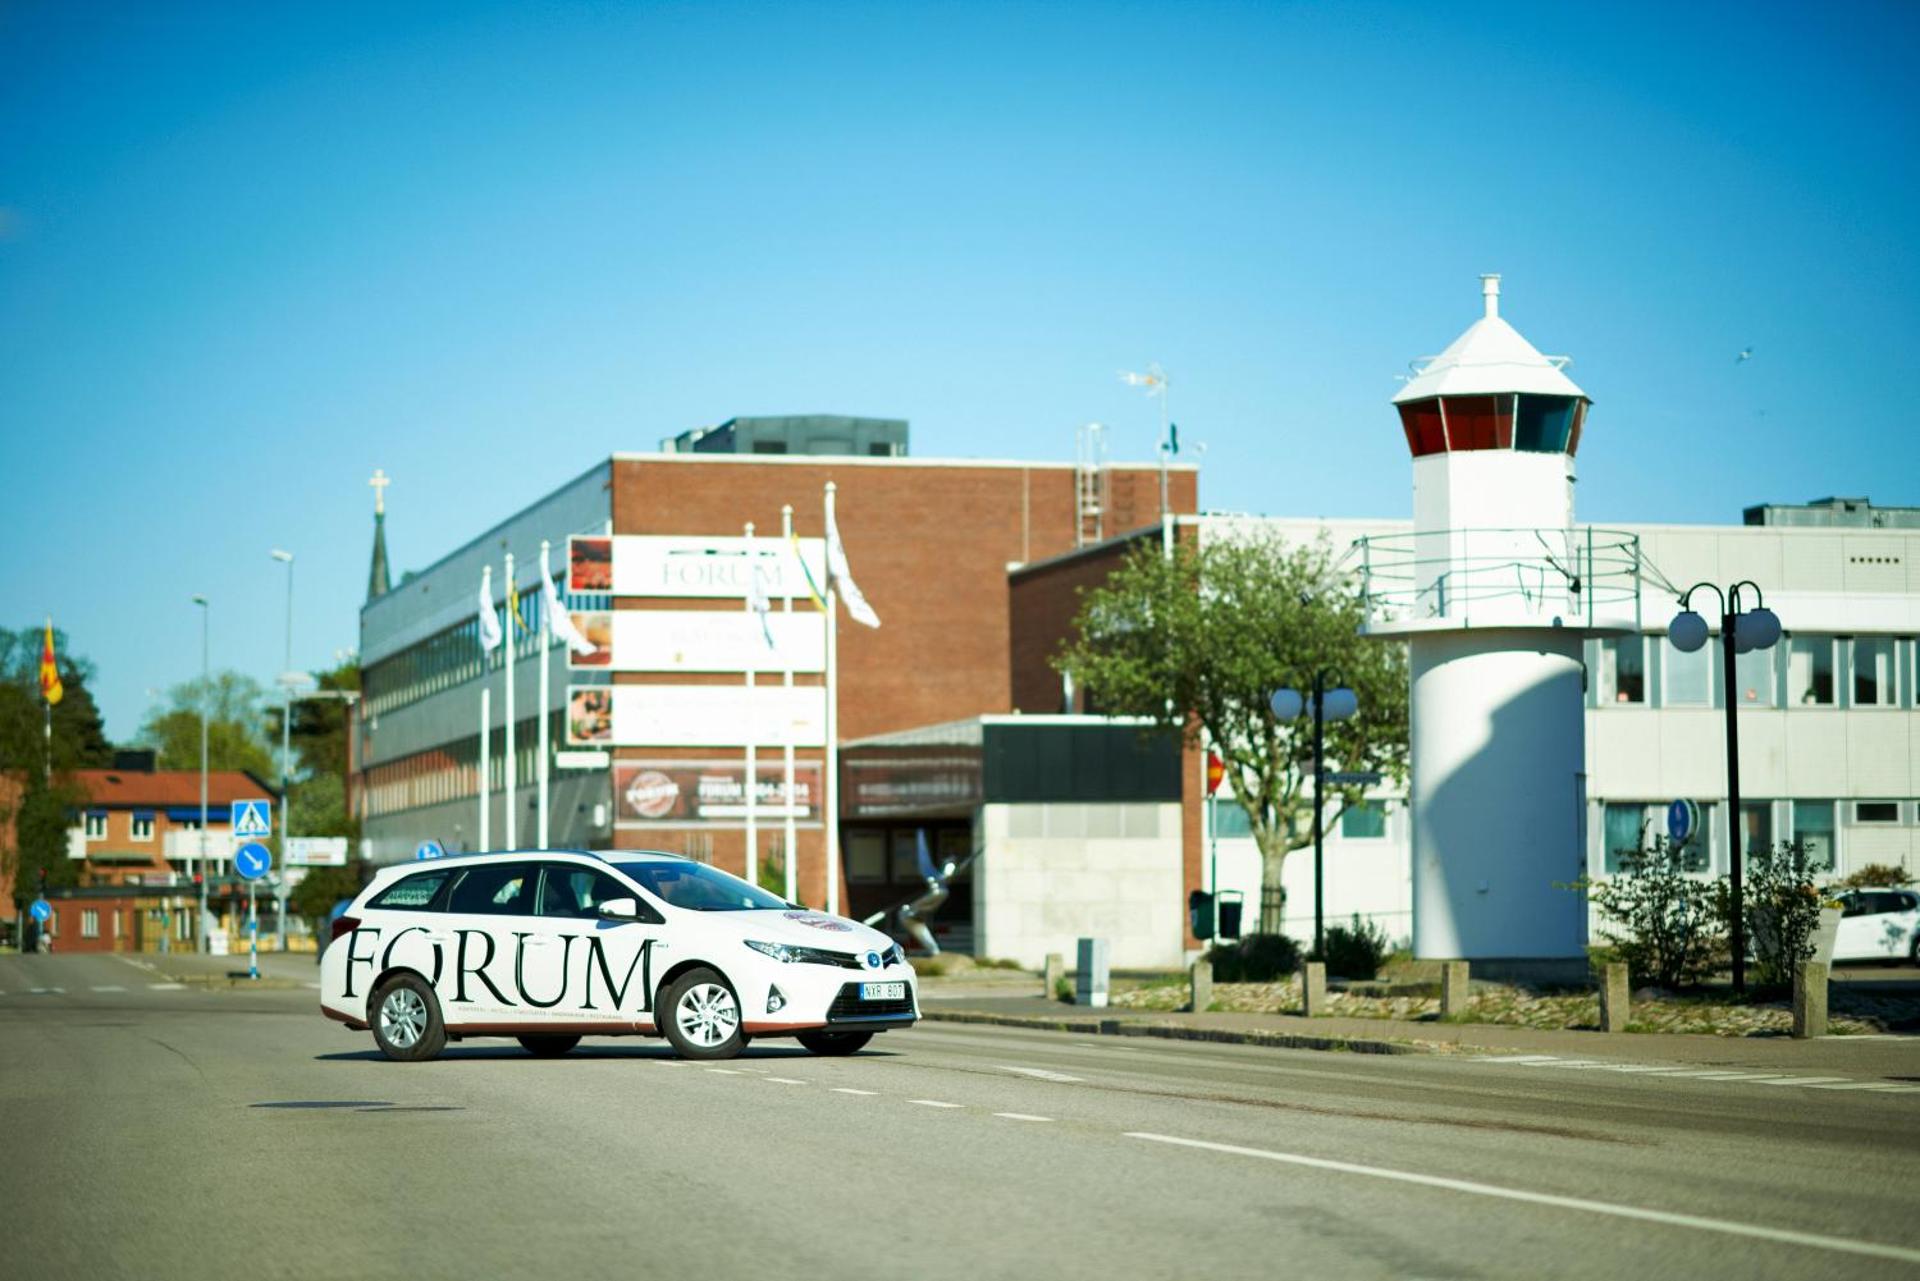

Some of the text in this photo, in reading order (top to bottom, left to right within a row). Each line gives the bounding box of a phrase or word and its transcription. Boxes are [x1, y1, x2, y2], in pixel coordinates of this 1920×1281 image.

[341, 926, 658, 1013] FORUM
[865, 984, 903, 998] NXR 807
